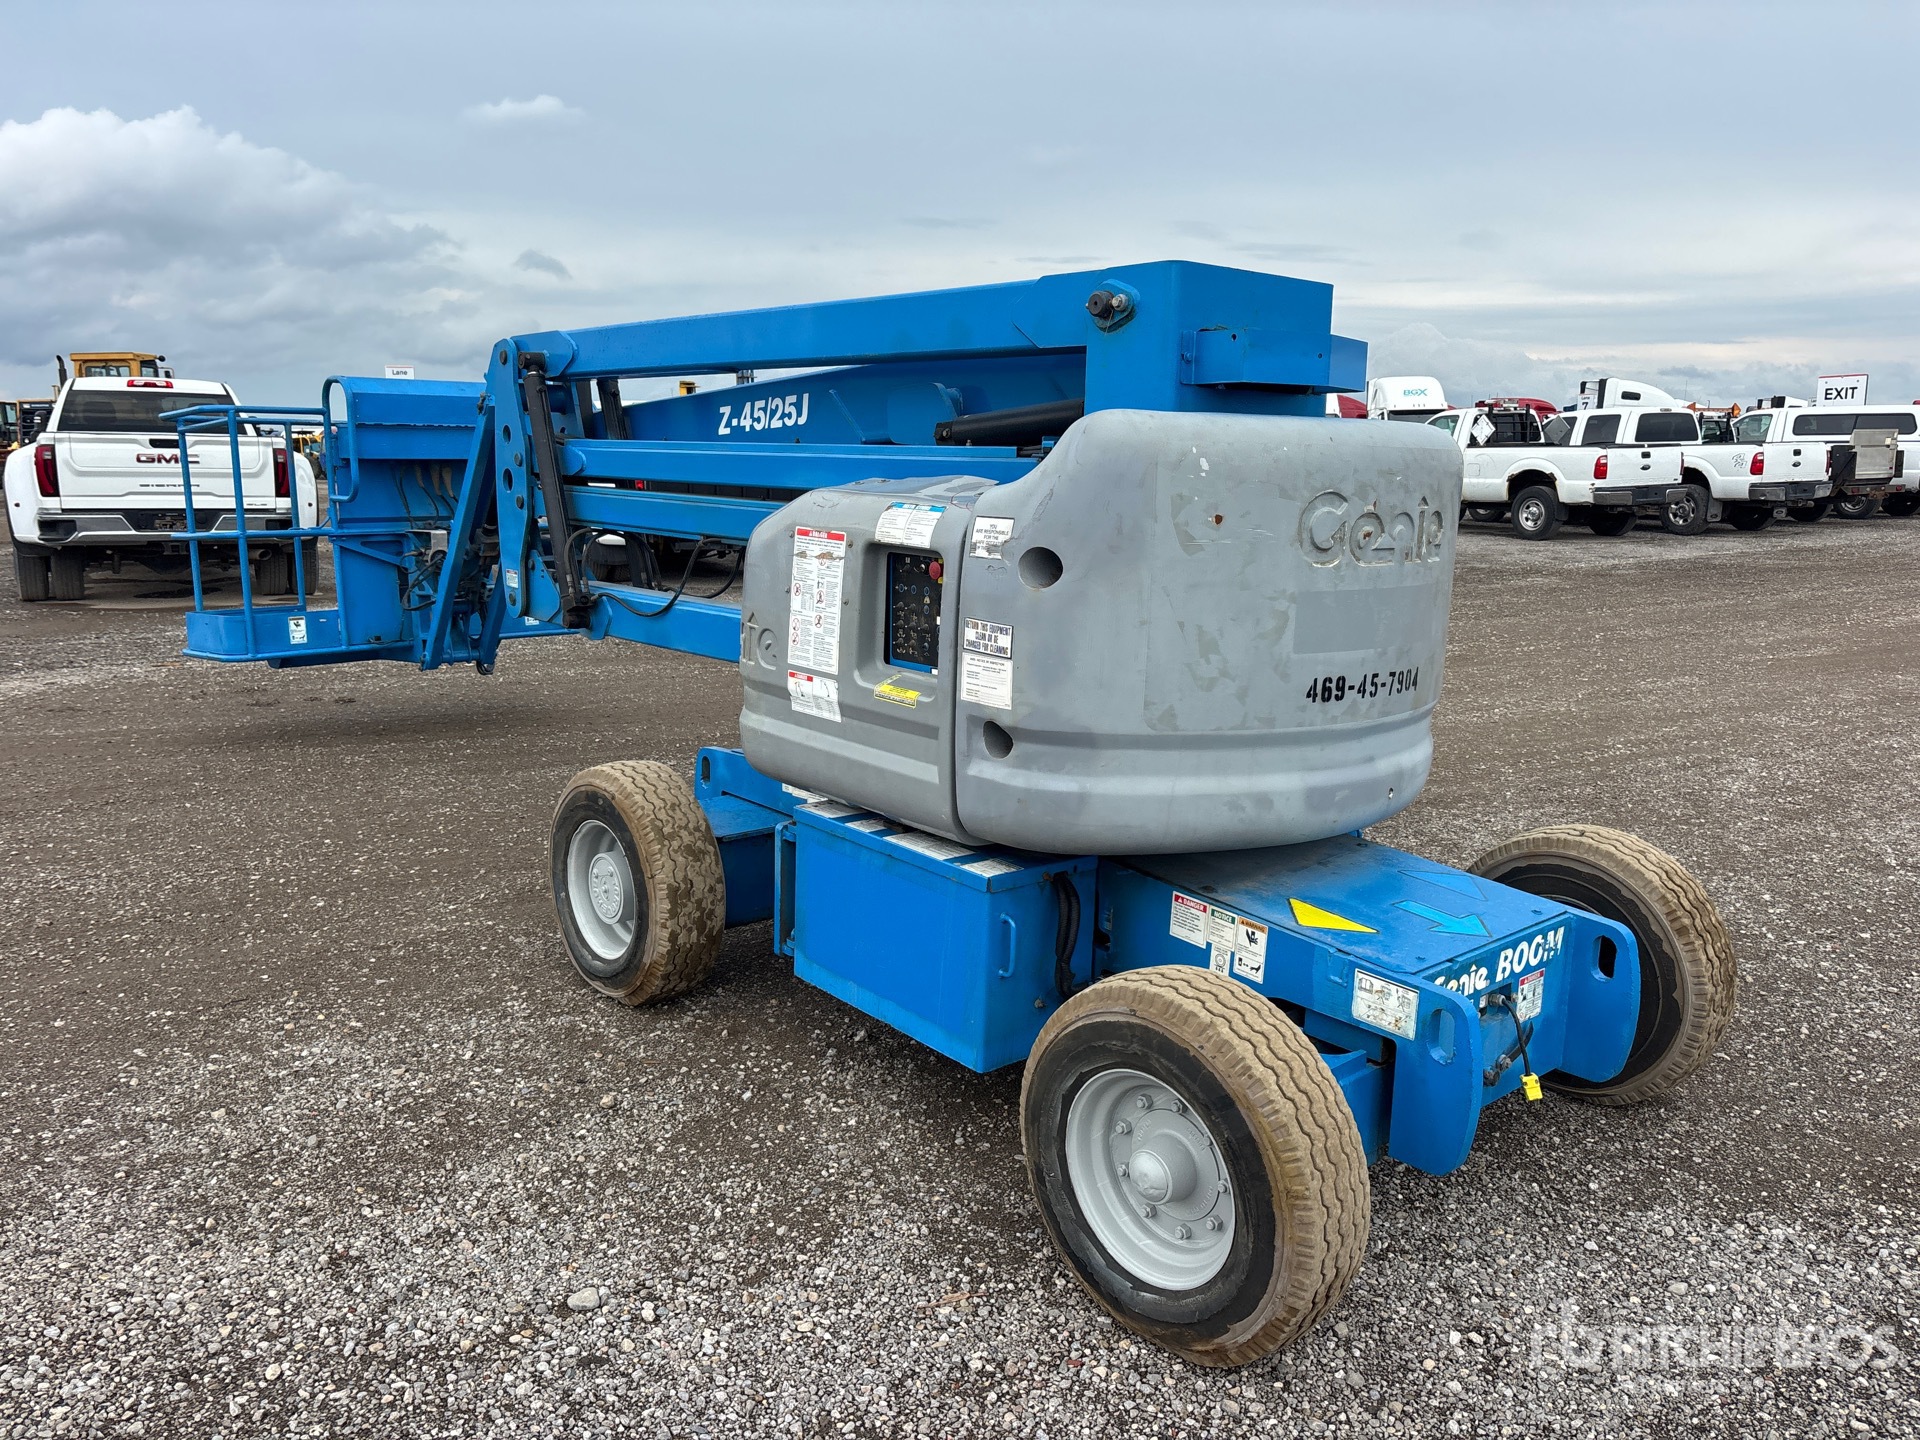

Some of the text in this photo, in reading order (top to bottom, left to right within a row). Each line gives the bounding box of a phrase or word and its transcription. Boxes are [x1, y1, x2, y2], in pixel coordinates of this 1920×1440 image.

[1403, 388, 1428, 397] BGX
[1824, 386, 1858, 400] EXIT
[1581, 401, 1589, 410] 7
[718, 392, 810, 436] Z-45/25J
[136, 453, 200, 464] GMC
[1298, 489, 1445, 568] Genie
[989, 624, 1011, 636] EQUIPMENT
[1305, 666, 1420, 704] 469-45-7904
[1183, 898, 1204, 912] DANGER
[1213, 910, 1232, 923] NOTICE
